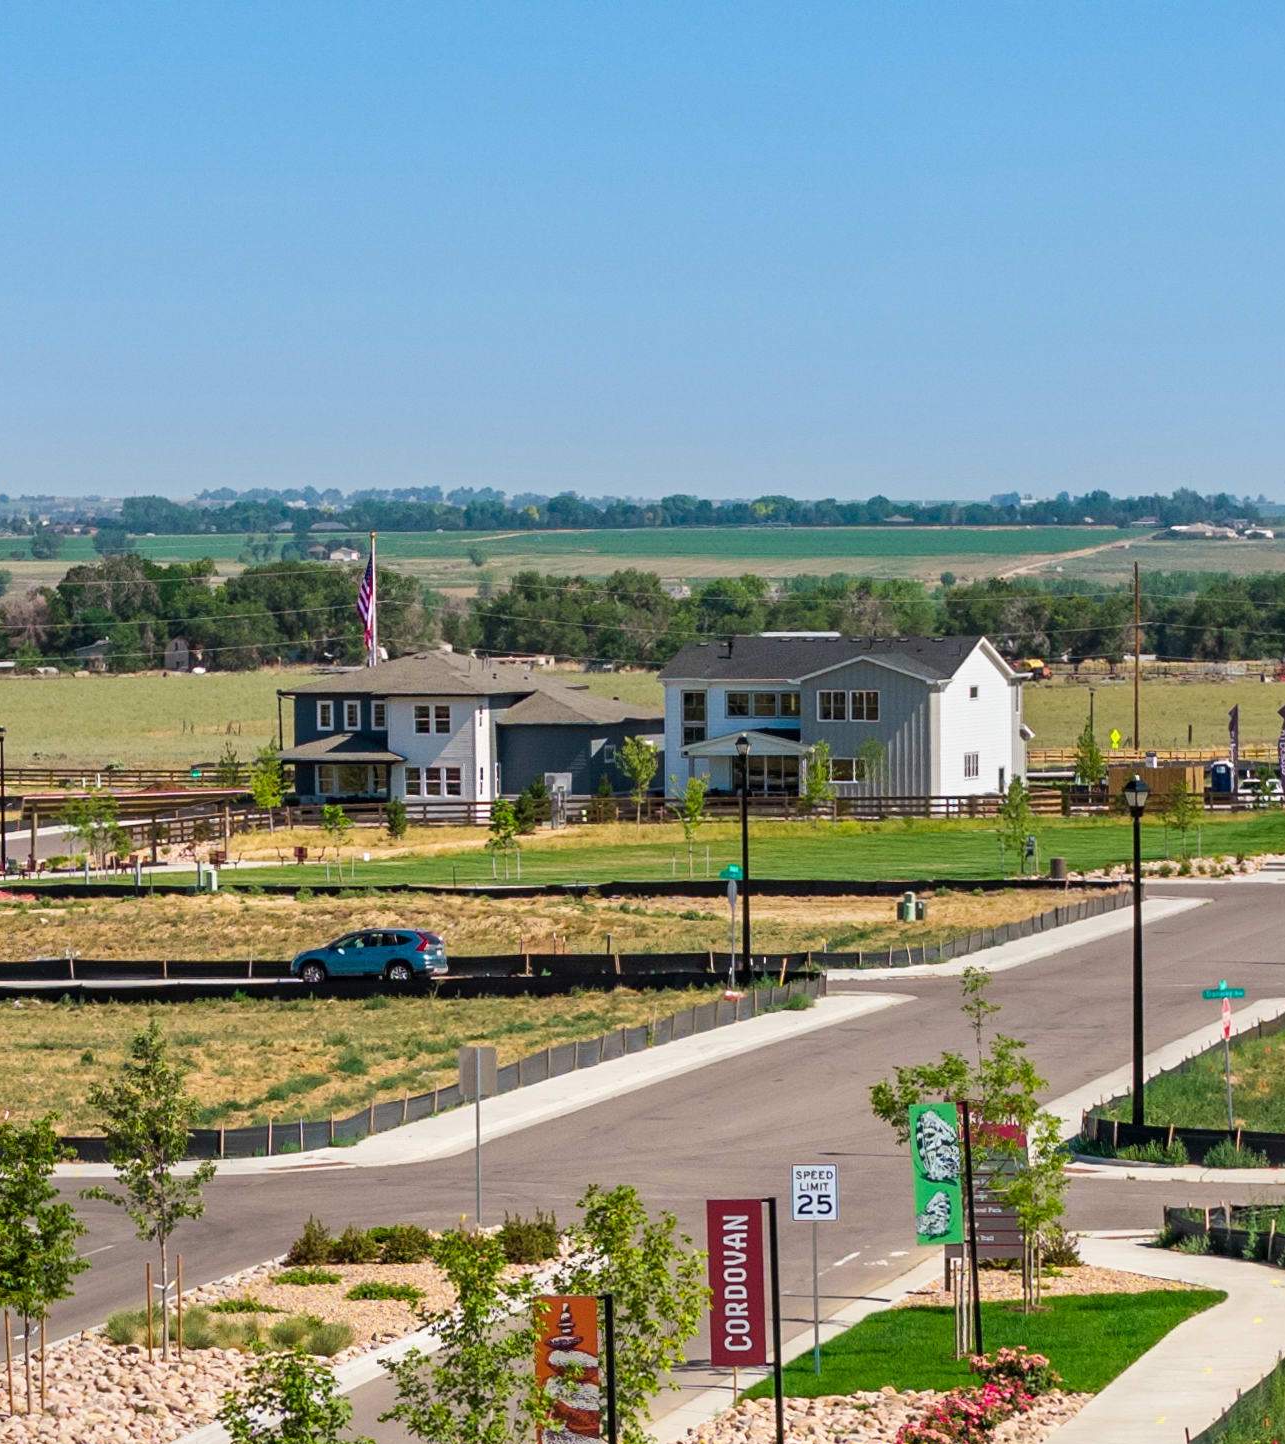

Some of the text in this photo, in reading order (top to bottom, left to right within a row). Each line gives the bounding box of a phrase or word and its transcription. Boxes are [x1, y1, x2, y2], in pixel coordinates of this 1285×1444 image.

[796, 1170, 833, 1180] SPEED
[799, 1182, 829, 1191] LIMIT
[797, 1194, 833, 1214] 25
[722, 1215, 753, 1351] CORDOVAN
